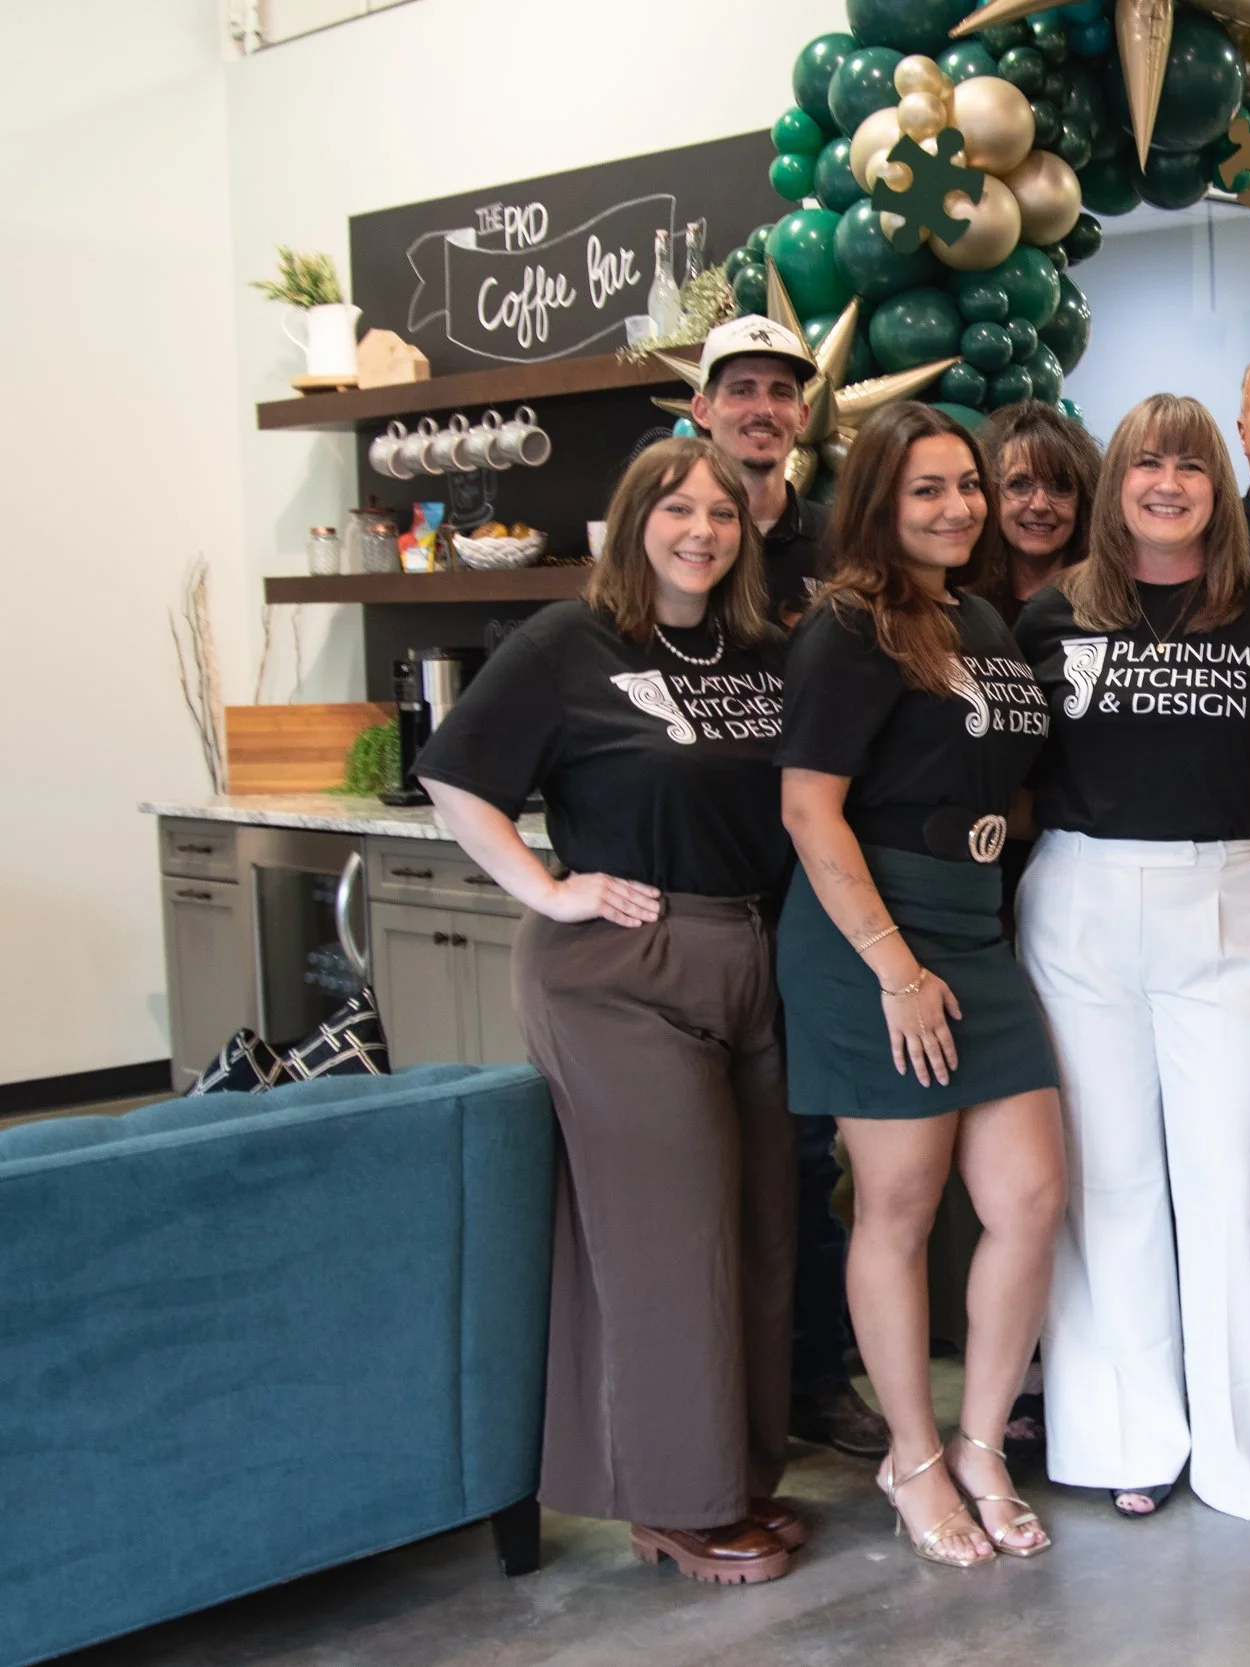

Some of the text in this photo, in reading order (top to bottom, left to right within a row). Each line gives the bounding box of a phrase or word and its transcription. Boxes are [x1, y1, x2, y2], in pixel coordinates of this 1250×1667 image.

[474, 202, 548, 252] THE PKD
[478, 235, 641, 348] Coffee Bar
[1112, 641, 1250, 667] PLATINUM
[1105, 667, 1248, 690] KITCHENS
[980, 680, 1049, 707] KITCHE
[1099, 692, 1247, 719] & DESIGN
[701, 718, 782, 740] & DESI
[993, 708, 1005, 731] &
